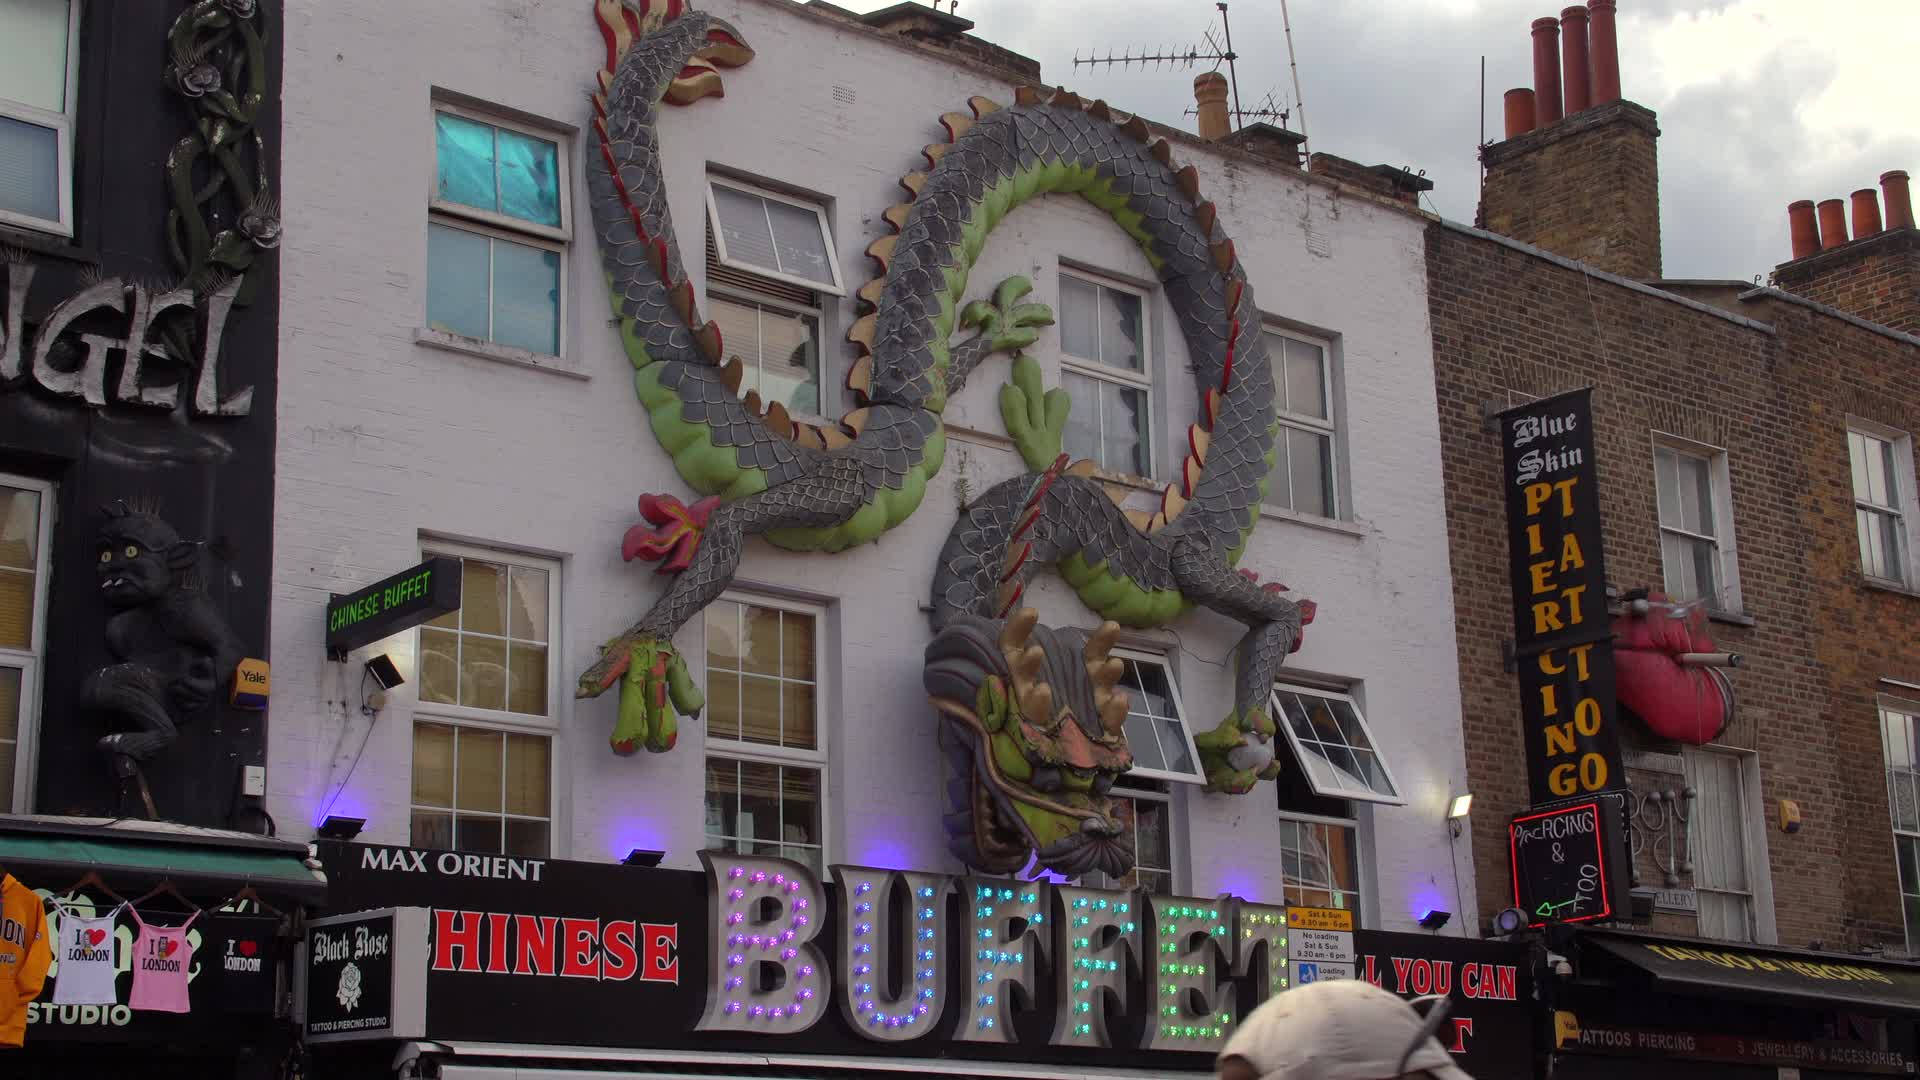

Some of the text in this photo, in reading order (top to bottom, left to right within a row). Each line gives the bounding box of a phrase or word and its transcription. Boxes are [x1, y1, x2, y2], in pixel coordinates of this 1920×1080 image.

[1513, 412, 1577, 448] Blue
[1516, 445, 1583, 486] Skin
[330, 571, 431, 632] CHINESE BUFFET
[241, 670, 266, 684] Yale
[1552, 842, 1565, 862] &
[361, 847, 545, 882] MAX ORIENT
[1655, 889, 1696, 908] ELLERY
[75, 929, 81, 945] I
[313, 924, 389, 966] Black Rose
[428, 906, 679, 986] HINESE
[1314, 932, 1339, 941] loading
[68, 948, 109, 962] LONDON
[150, 939, 155, 955] I
[227, 939, 236, 956] I
[1297, 950, 1313, 958] 9.30
[142, 958, 181, 973] LONDON
[1319, 967, 1345, 975] Loading
[1391, 956, 1453, 995] YOU
[1461, 962, 1517, 1000] CAN
[27, 1002, 131, 1026] STUDIO
[310, 1016, 387, 1032] TATTOO & PIERCING STUDIO
[1577, 1029, 1632, 1047] TATTOOS
[1638, 1031, 1696, 1050] PIERCING
